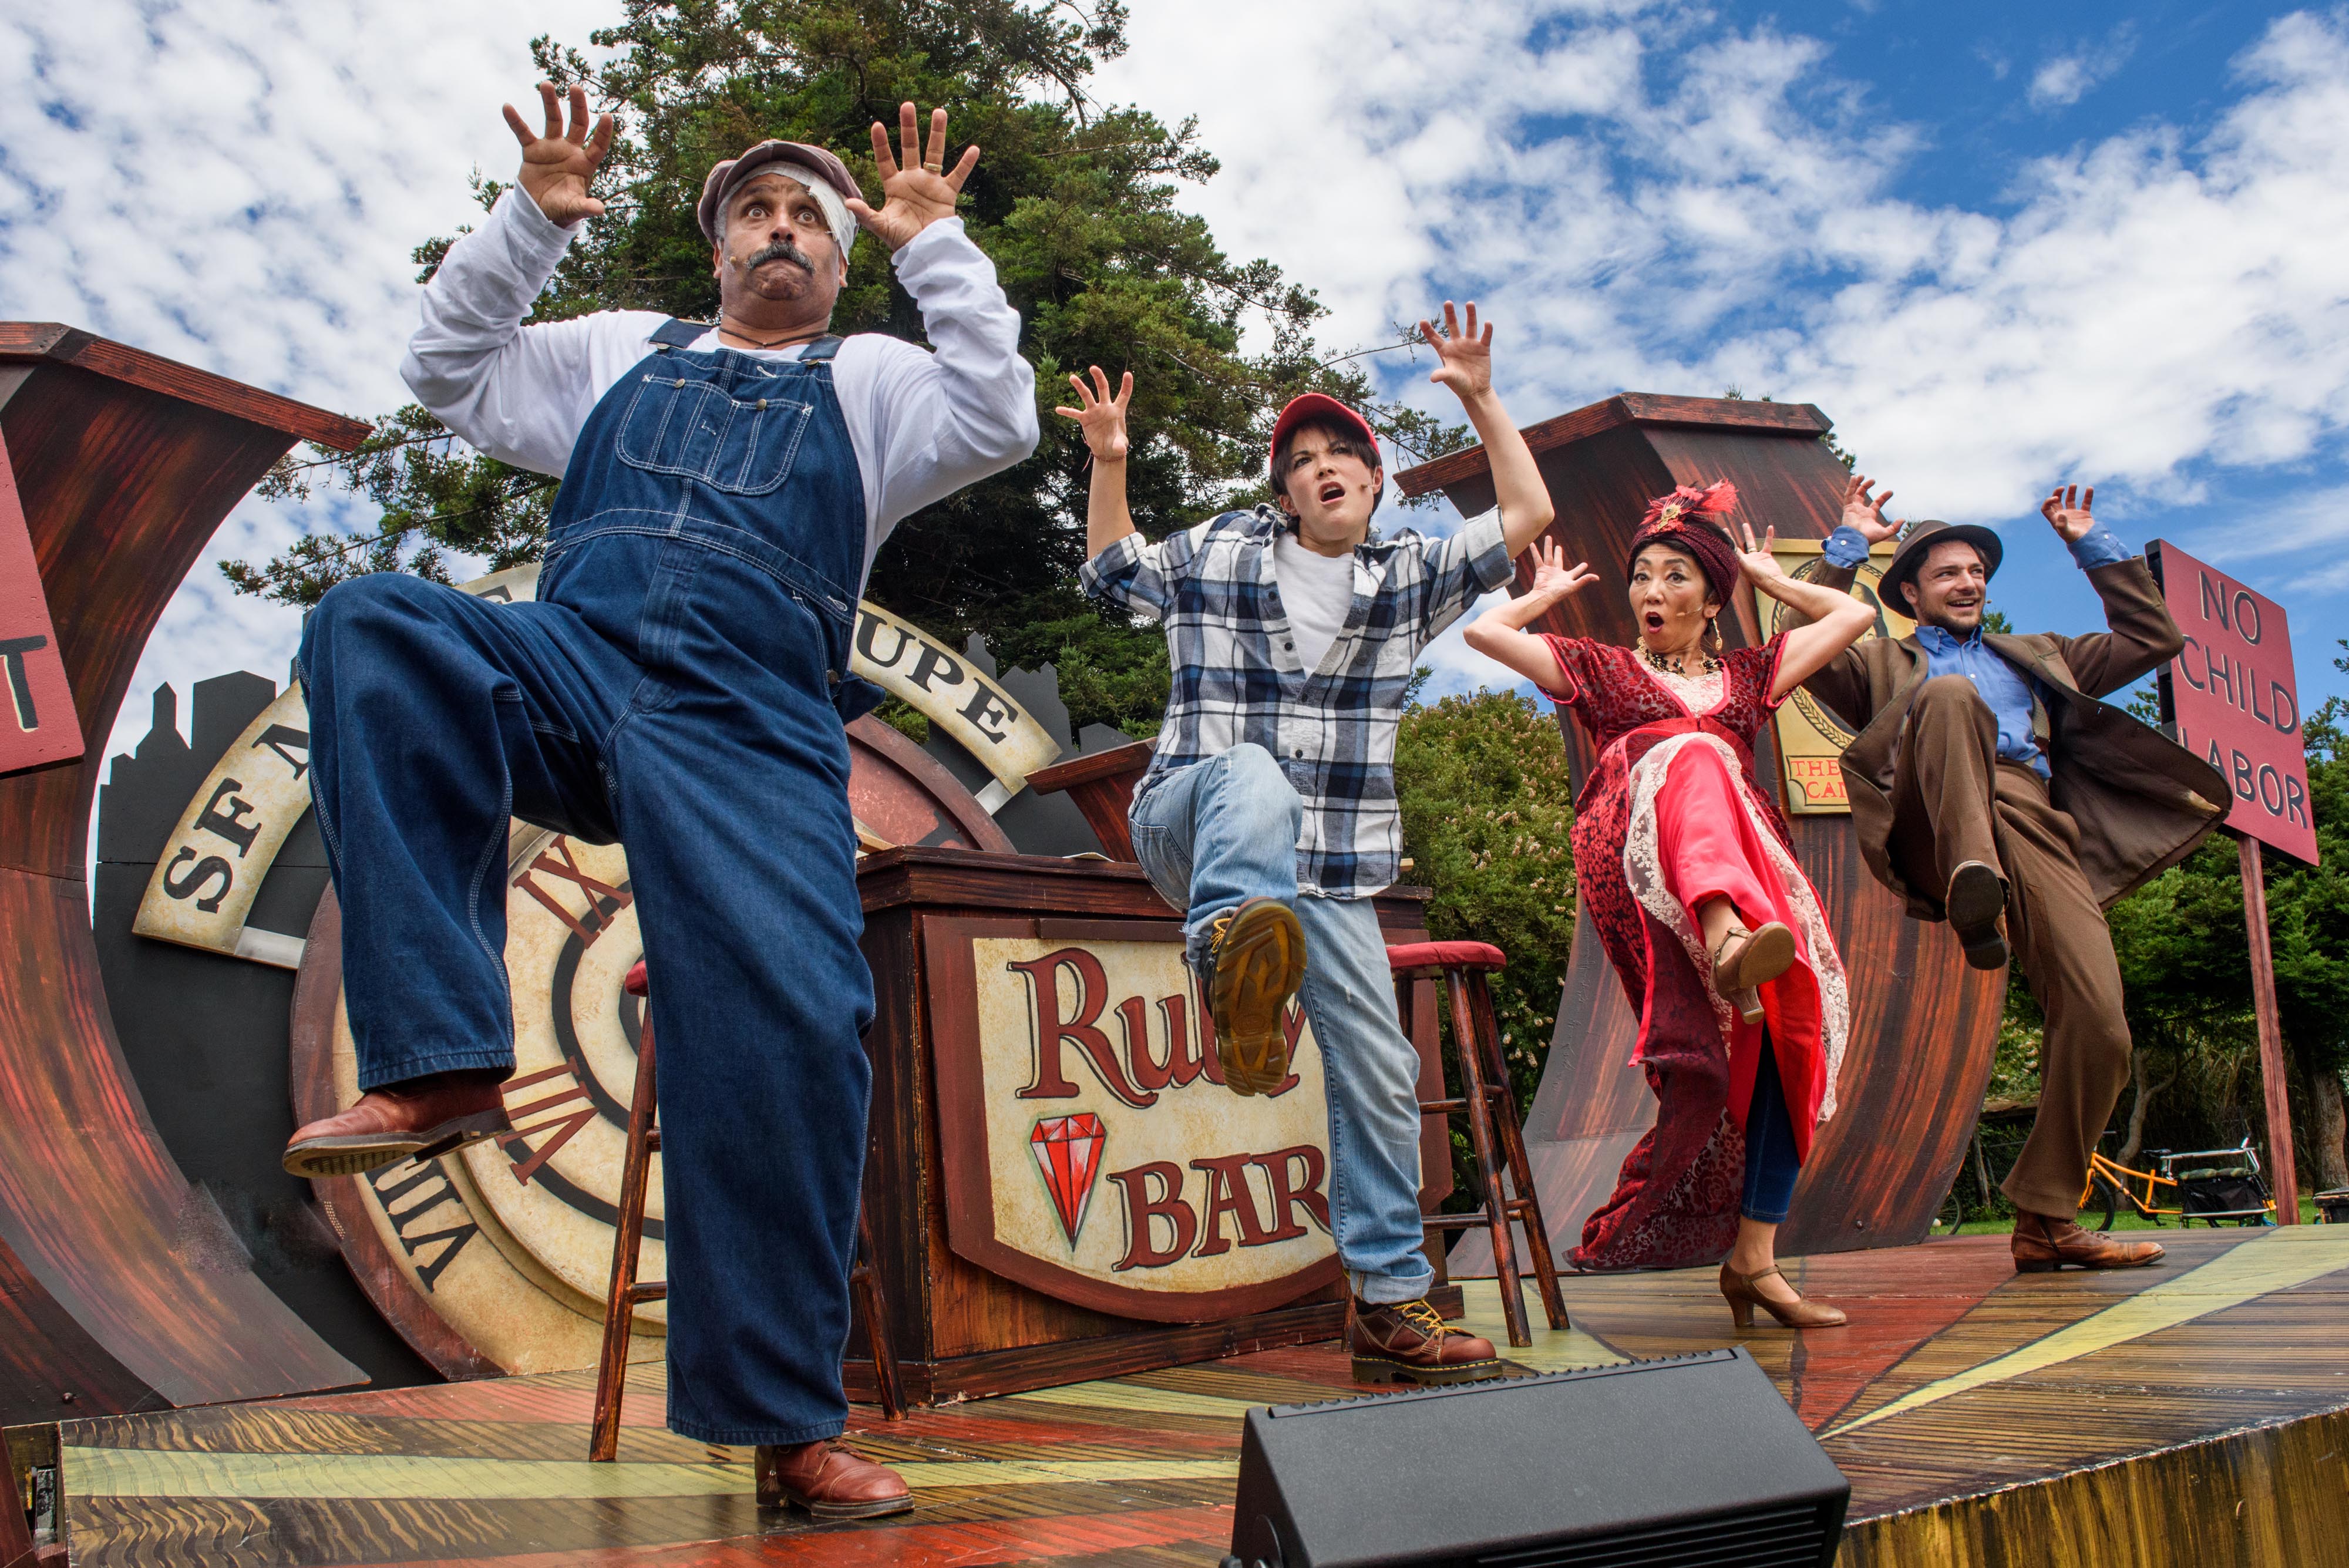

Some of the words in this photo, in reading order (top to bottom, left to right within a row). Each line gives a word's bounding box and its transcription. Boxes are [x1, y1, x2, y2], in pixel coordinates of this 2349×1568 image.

[2198, 570, 2261, 645] NO
[2178, 634, 2297, 734] CHILD
[1791, 760, 1840, 776] THE
[163, 777, 263, 913] SF
[1106, 1145, 1334, 1273] BAR
